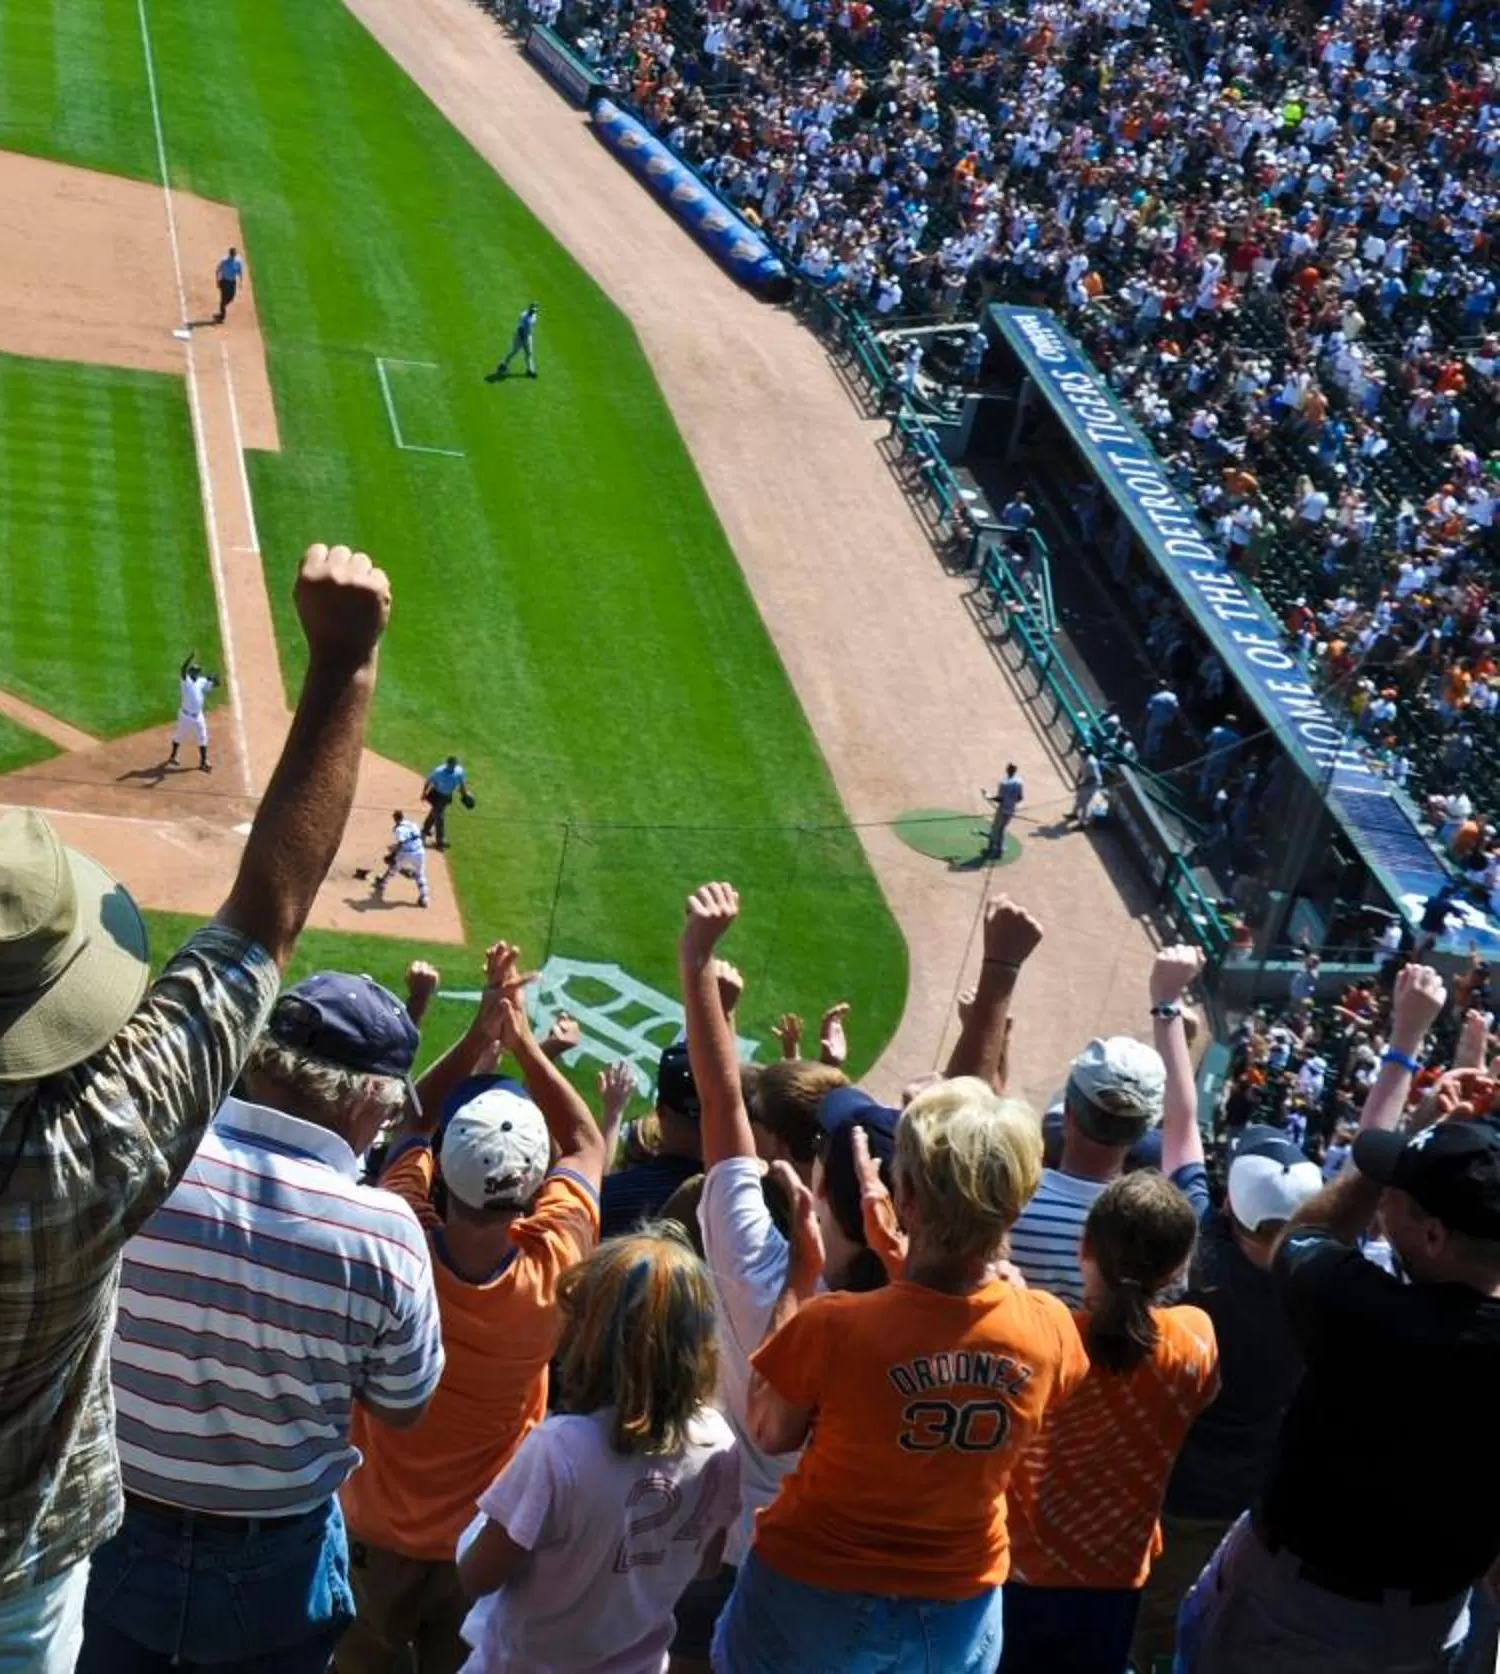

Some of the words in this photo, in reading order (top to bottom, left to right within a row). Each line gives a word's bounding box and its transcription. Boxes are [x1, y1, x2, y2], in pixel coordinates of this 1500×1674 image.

[1051, 369, 1134, 443] TIGERS
[1107, 451, 1217, 561] DETROIT
[1188, 569, 1260, 621] THE
[1232, 630, 1293, 669] OF
[1266, 679, 1371, 774] HOME
[897, 1399, 1011, 1453] 30
